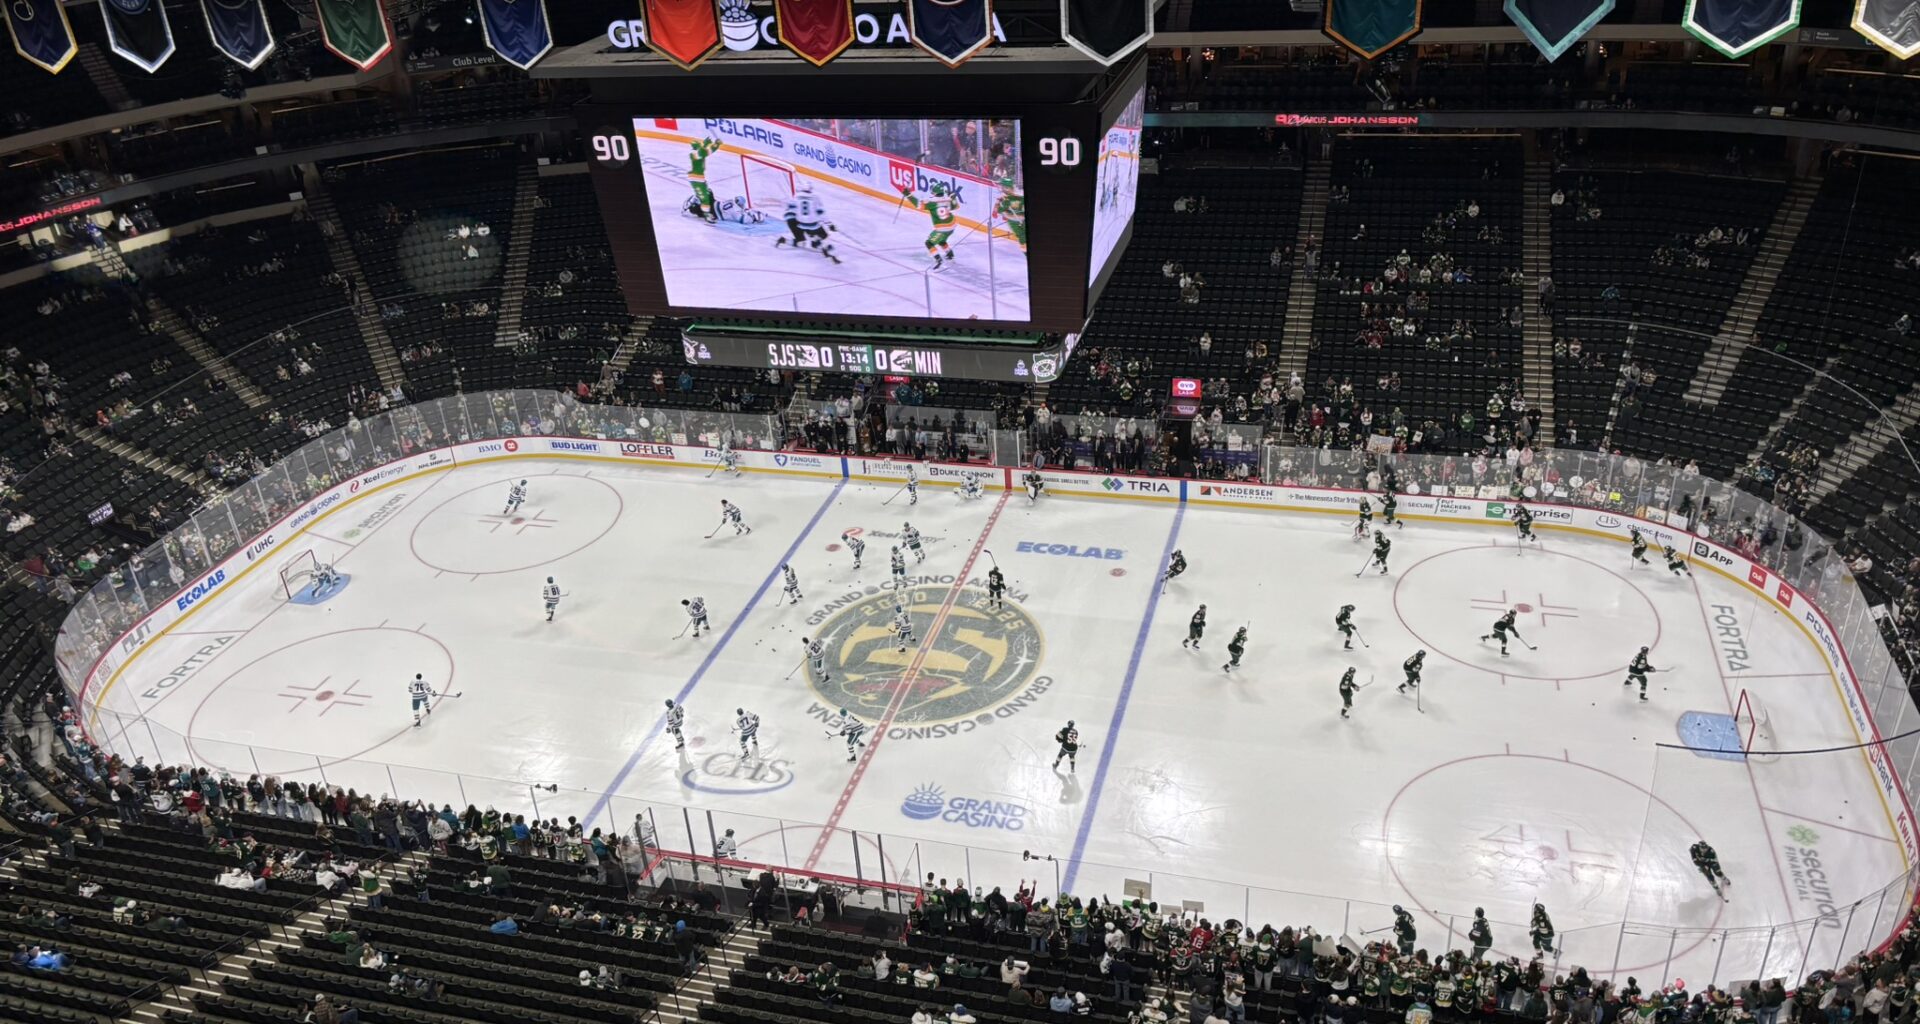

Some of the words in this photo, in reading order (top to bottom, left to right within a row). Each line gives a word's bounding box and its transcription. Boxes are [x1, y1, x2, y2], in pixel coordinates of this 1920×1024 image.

[452, 57, 472, 67] Club
[473, 54, 496, 65] Level
[1328, 116, 1418, 124] JOHANSSON
[703, 119, 784, 149] POLARIS
[591, 134, 630, 162] 90
[1038, 137, 1082, 167] 90
[793, 142, 826, 163] GRAND
[836, 156, 872, 178] CASINO
[890, 168, 915, 188] us
[15, 197, 102, 228] JOHANSSON
[768, 344, 796, 366] SJS
[820, 346, 834, 368] 0
[840, 352, 868, 364] 13:14
[875, 350, 888, 370] 0
[914, 350, 942, 374] MIN
[478, 444, 502, 454] BMO
[551, 440, 571, 450] BUD
[571, 442, 598, 452] LIGHT
[620, 442, 674, 456] LOFFLER
[790, 456, 822, 464] FANDUEL
[362, 472, 380, 486] Xcel
[380, 464, 404, 480] Energy
[1128, 480, 1170, 492] TRIA
[1223, 488, 1273, 496] ANDERSEN
[1304, 494, 1333, 502] Minnesota
[290, 510, 311, 529] GRAND
[316, 492, 341, 511] CASINO
[1598, 514, 1620, 526] CHS
[1626, 523, 1674, 542] chsinc.com
[254, 534, 275, 554] UHC
[1016, 540, 1128, 561] ECOLAB
[176, 569, 226, 611] ECOLAB
[805, 590, 864, 627] GRAND
[966, 576, 1030, 604] ARNA
[1711, 604, 1752, 673] FORTRA
[1806, 611, 1841, 669] POLARIS
[141, 636, 235, 700] FORTRA
[995, 676, 1054, 720] GRAND
[887, 720, 977, 741] CASINO
[1066, 734, 1078, 744] 55
[702, 752, 789, 784] CHS
[1876, 752, 1894, 798] bank
[947, 796, 1029, 819] GRAND
[941, 808, 1026, 832] CASINO
[1784, 846, 1811, 901] FINANCIAL
[1800, 848, 1843, 930] securian
[1438, 992, 1450, 1000] 97
